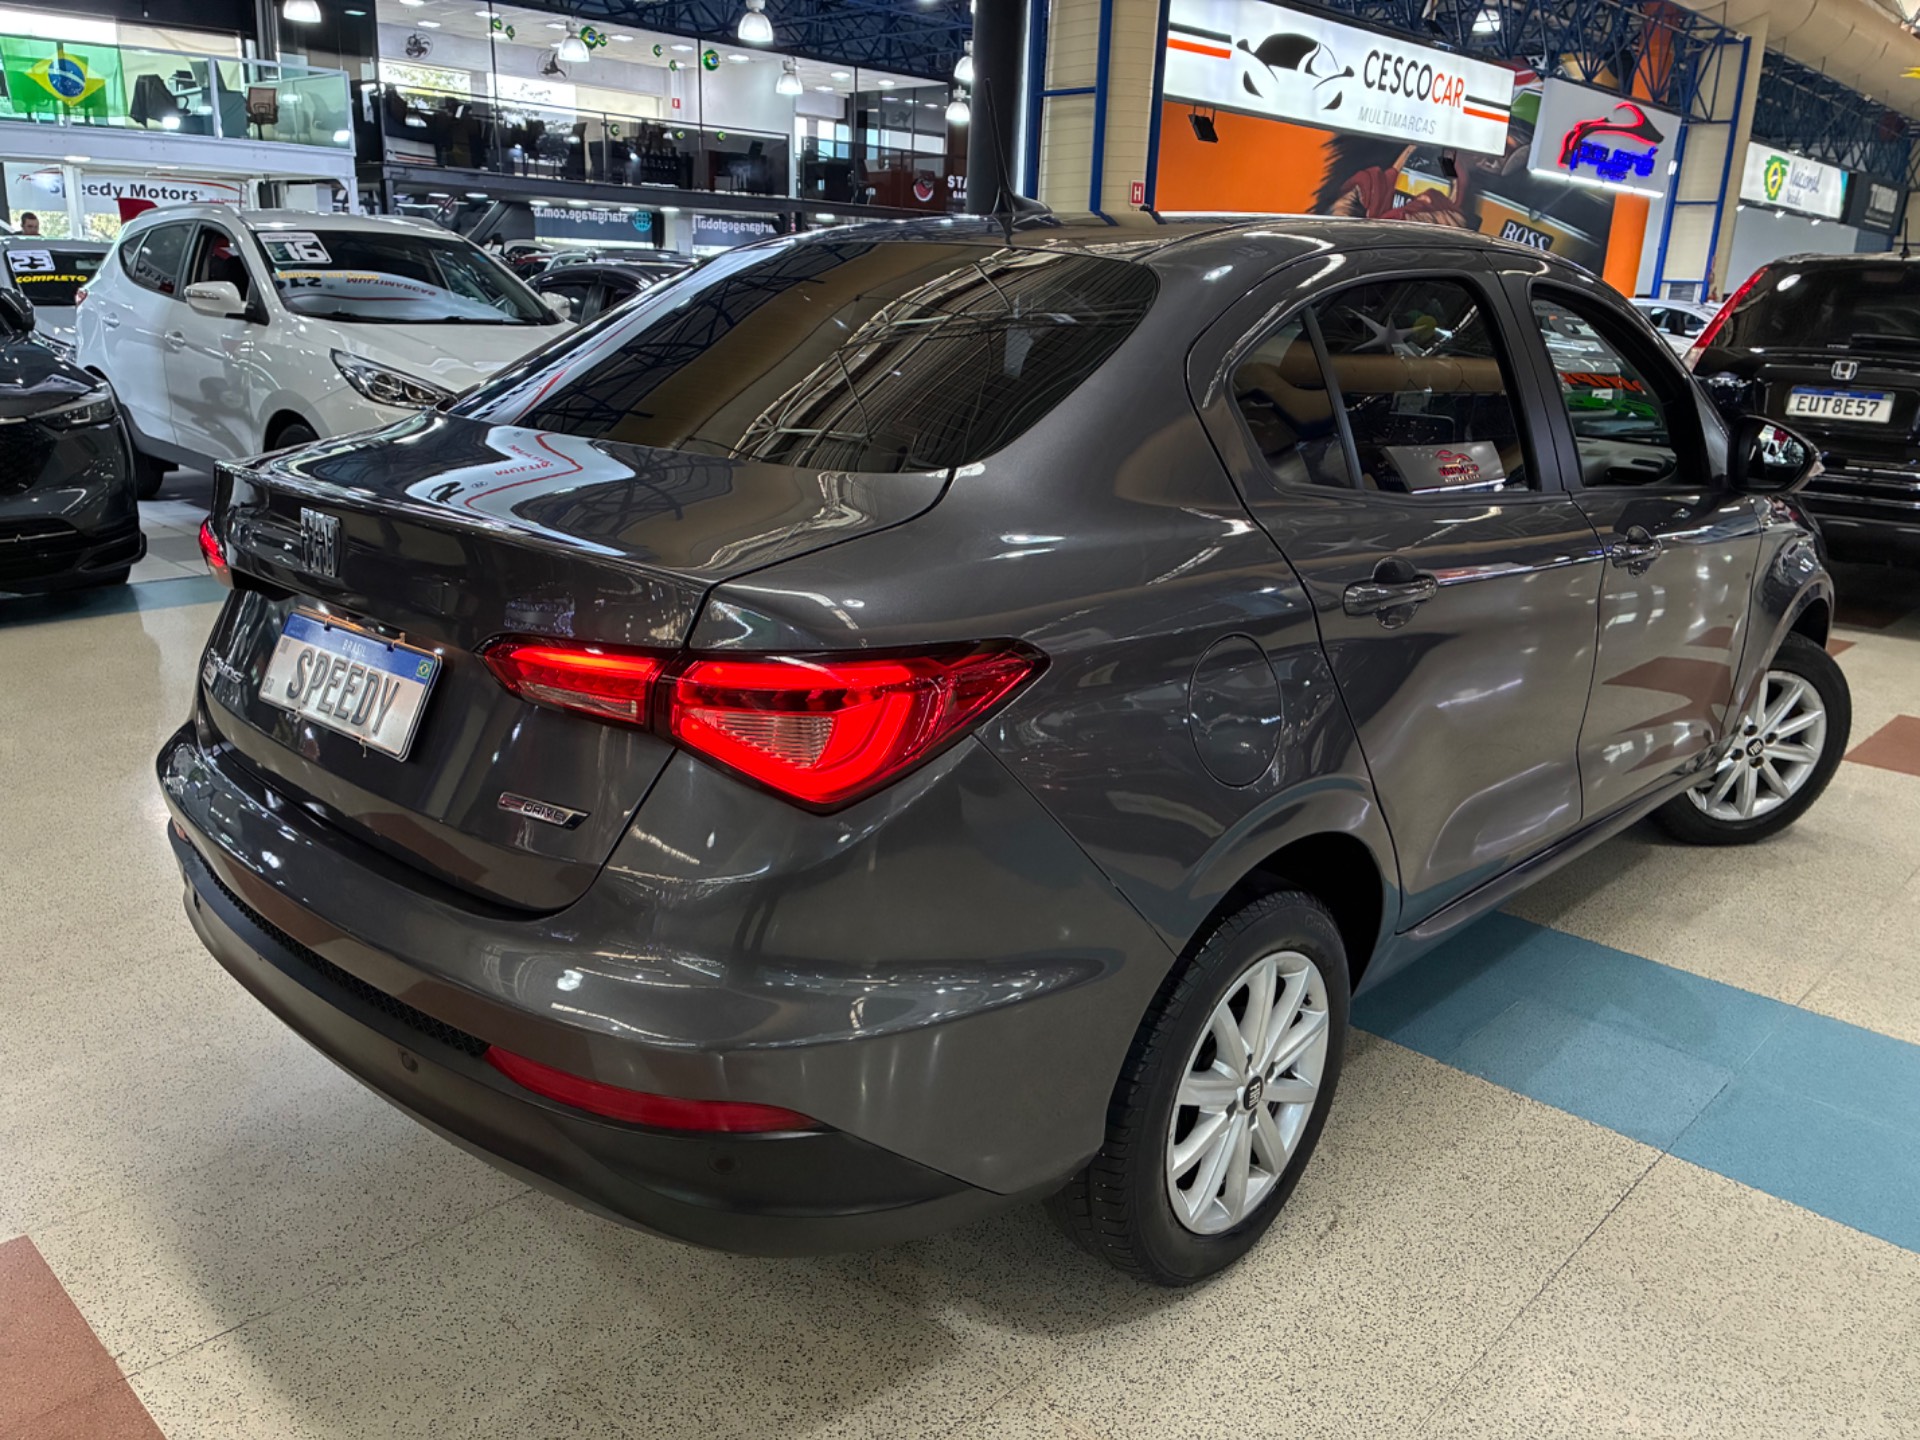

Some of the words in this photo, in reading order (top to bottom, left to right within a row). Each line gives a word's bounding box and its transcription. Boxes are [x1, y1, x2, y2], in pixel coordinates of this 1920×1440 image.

[1363, 49, 1465, 108] CESCOCAR
[1358, 106, 1437, 135] MULTIMARCAS
[947, 174, 967, 189] STA
[130, 183, 198, 201] Motors
[1502, 221, 1550, 250] BOSS
[284, 241, 328, 260] 16
[11, 255, 52, 271] 23
[16, 274, 88, 283] COMPLETO
[1795, 395, 1880, 417] EUT8E57
[286, 648, 400, 736] SPEEDY
